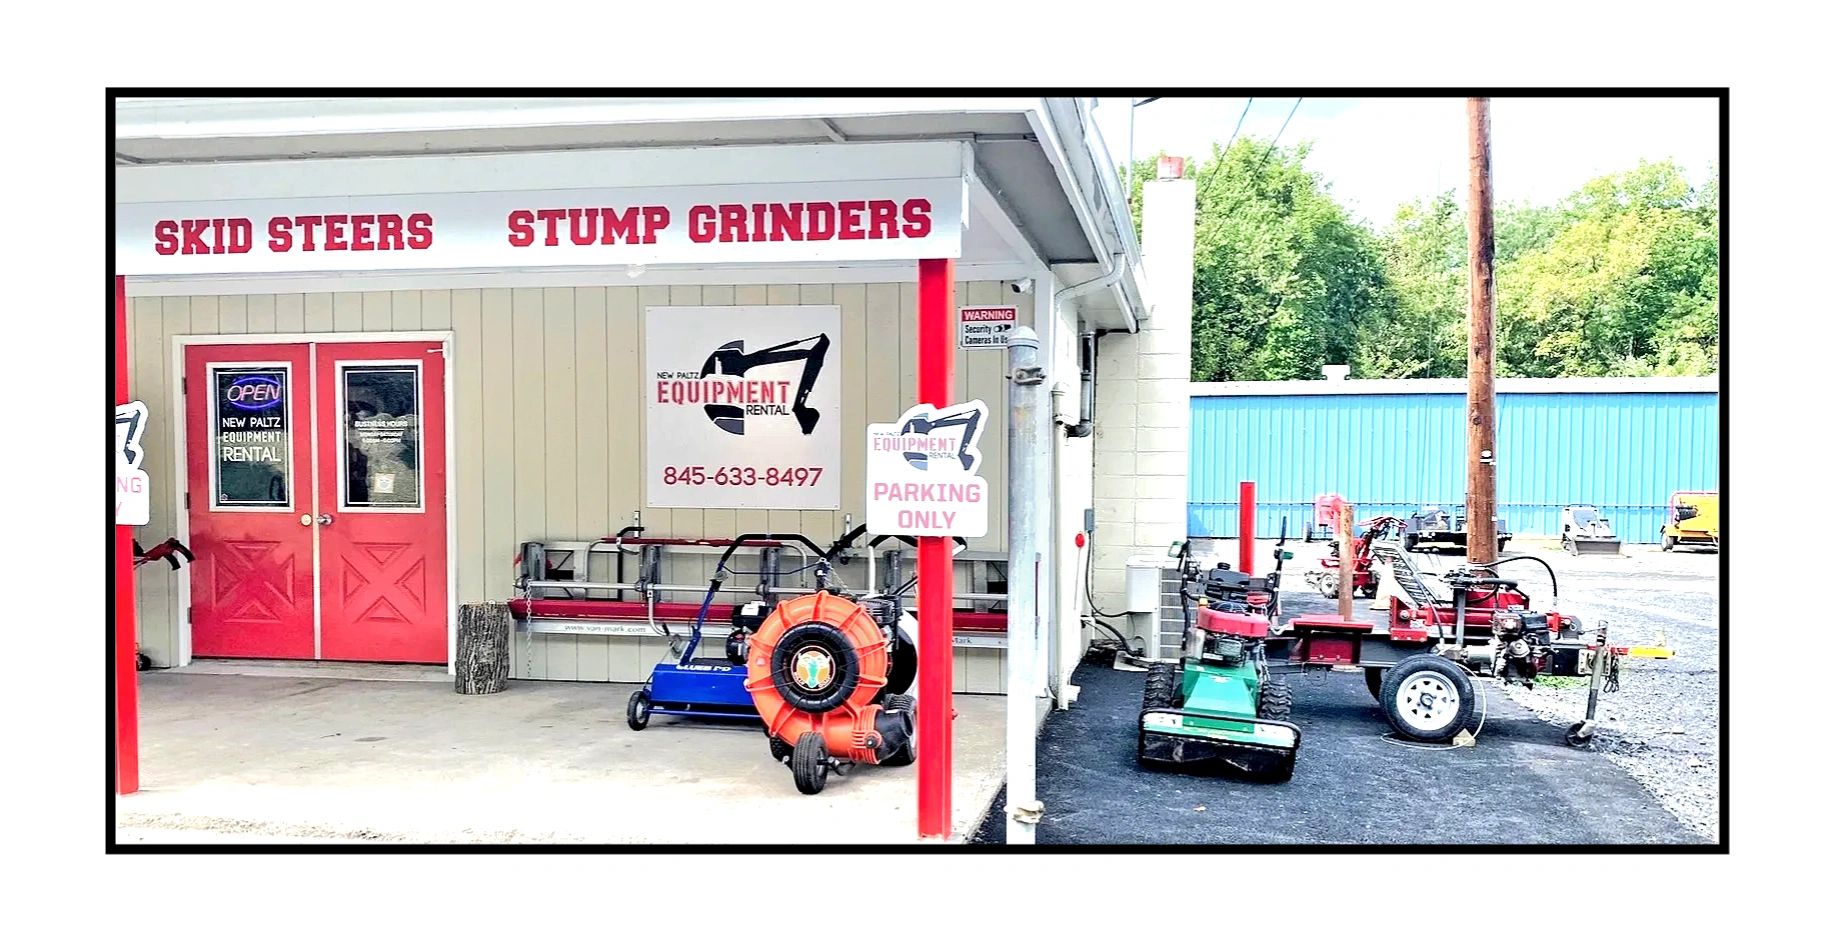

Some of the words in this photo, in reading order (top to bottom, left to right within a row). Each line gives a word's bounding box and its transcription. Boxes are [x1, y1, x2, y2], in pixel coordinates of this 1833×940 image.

[507, 206, 671, 247] STUMP
[688, 198, 932, 244] GRINDERS
[154, 218, 253, 255] SKID
[268, 213, 433, 252] STEERS
[964, 310, 1013, 320] WARNING
[965, 324, 991, 334] Security
[965, 335, 991, 344] Cameras
[227, 384, 281, 401] OPEN
[657, 380, 790, 404] EQUIPMENT
[746, 405, 789, 416] RENTAL
[222, 417, 246, 428] NEW
[250, 417, 281, 428] PALTZ
[223, 431, 281, 443] EQUIPMENT
[874, 437, 956, 452] EQUIPMENT
[223, 447, 281, 461] RENTAL
[664, 466, 823, 487] 845-633-8497
[874, 482, 981, 503] PARKING
[898, 510, 956, 529] ONLY
